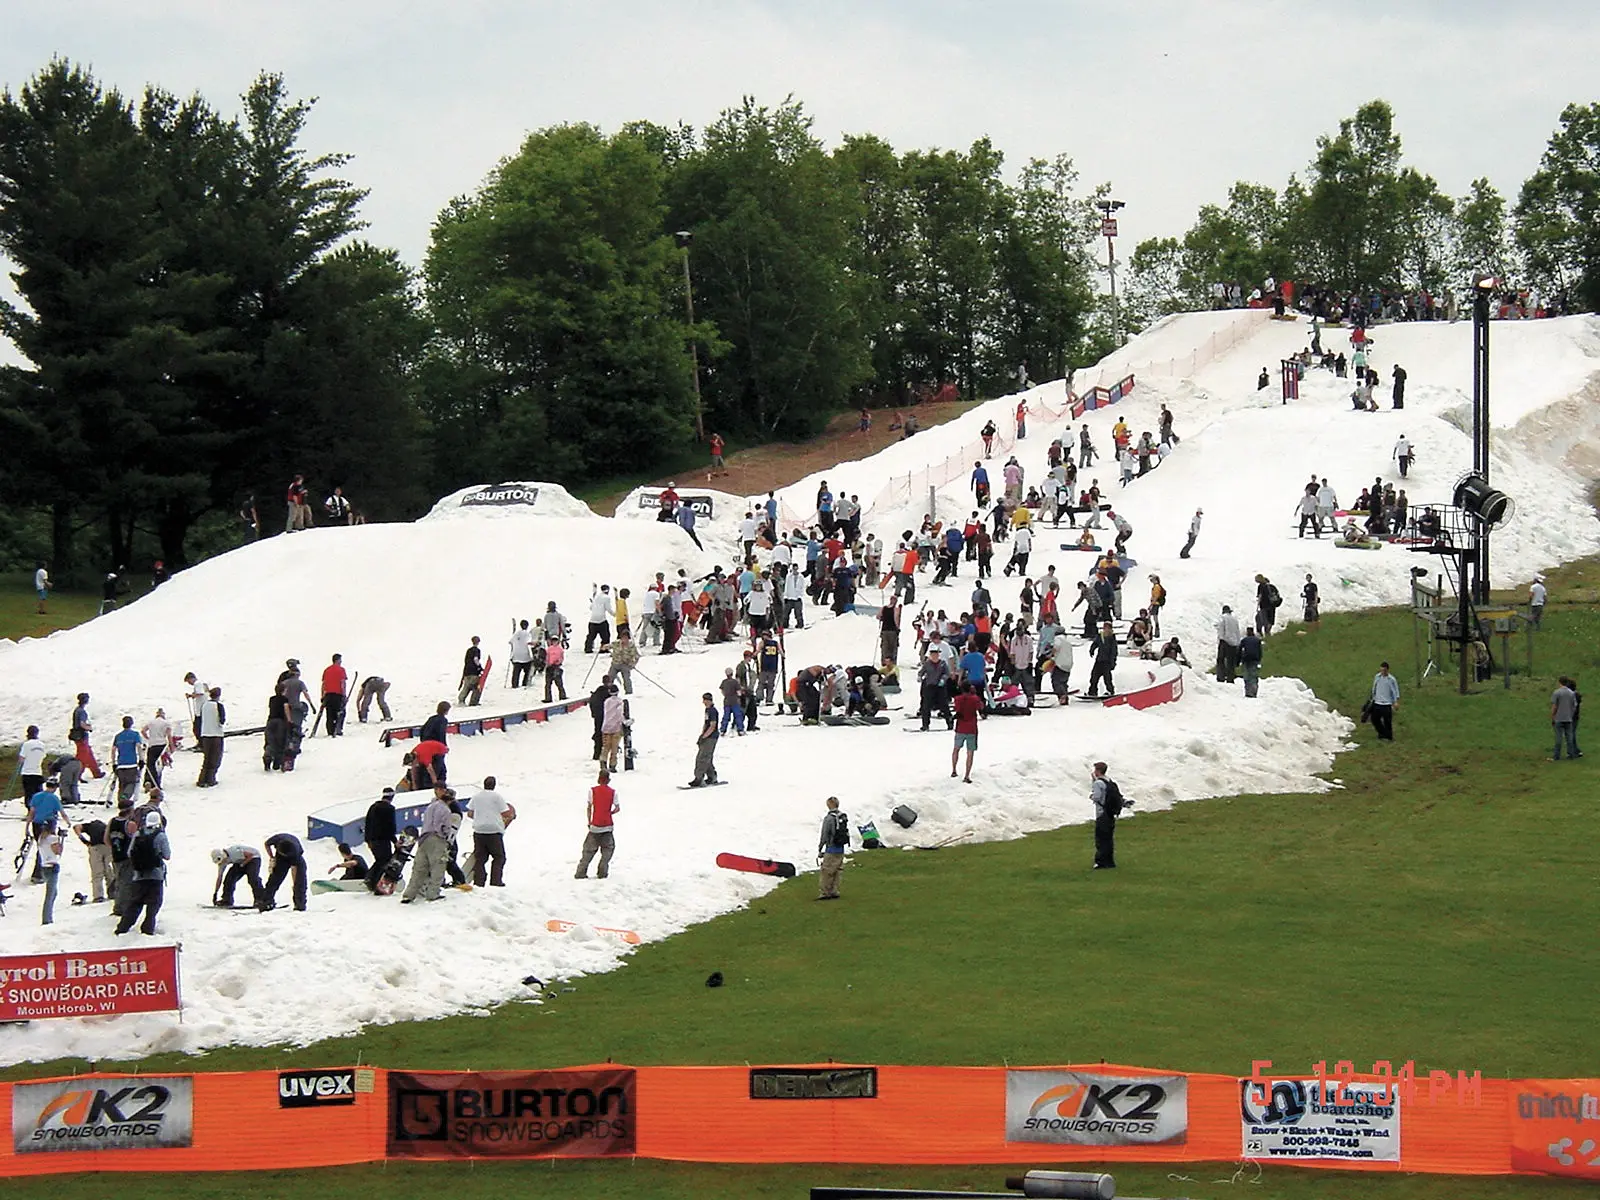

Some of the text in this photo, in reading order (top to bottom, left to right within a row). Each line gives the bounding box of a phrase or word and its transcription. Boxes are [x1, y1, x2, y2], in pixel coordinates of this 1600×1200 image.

[65, 956, 148, 979] Basin
[8, 984, 119, 1003] SNOWBOARD
[123, 980, 168, 997] AREA
[17, 1002, 116, 1015] Mount Horeb, WI
[280, 1075, 353, 1097] uvex
[86, 1085, 171, 1123] K2
[1080, 1084, 1166, 1119] K2
[1311, 1103, 1394, 1120] boardshop
[1362, 1128, 1390, 1137] Wind
